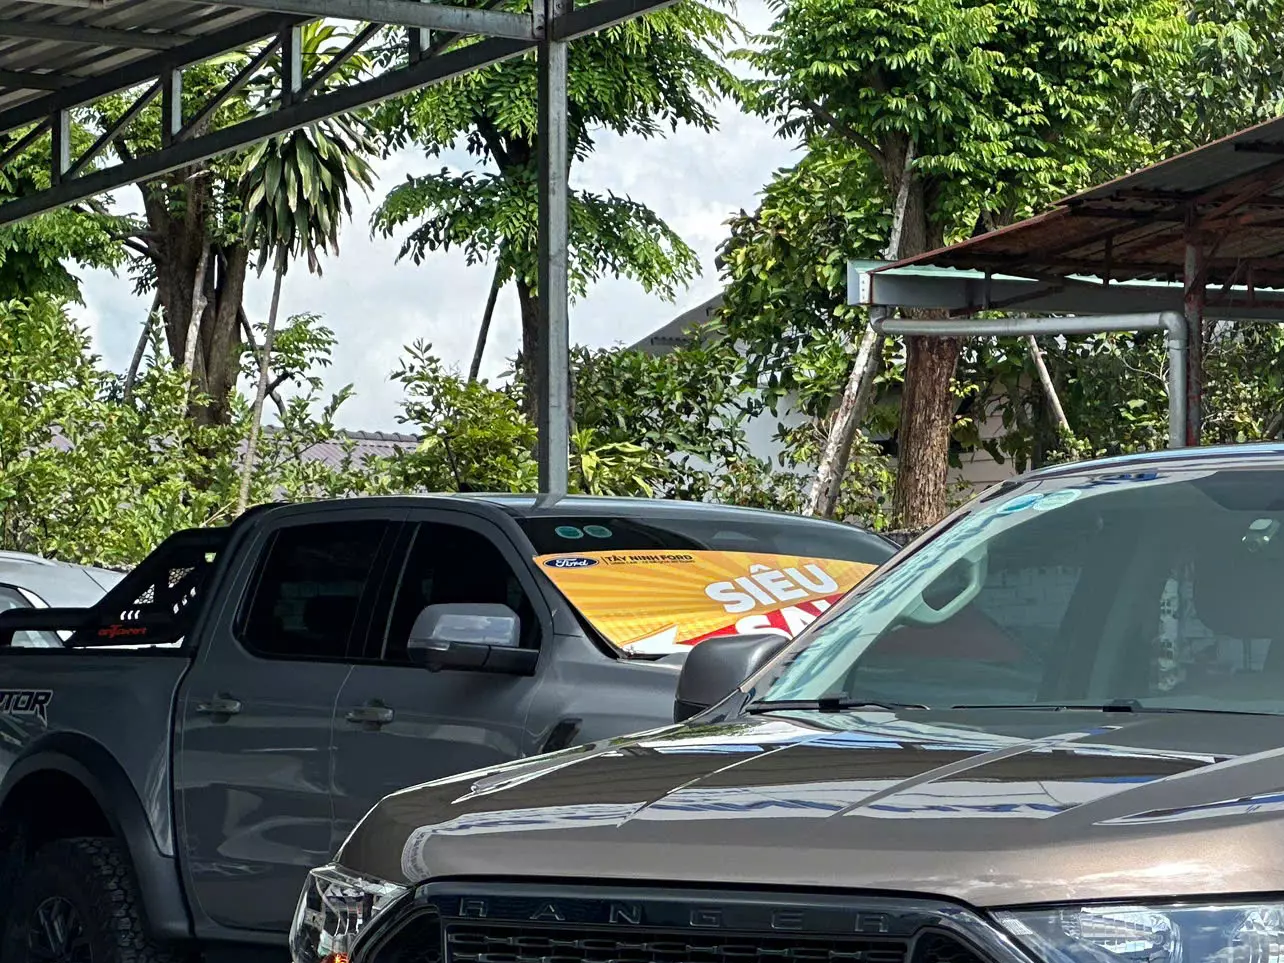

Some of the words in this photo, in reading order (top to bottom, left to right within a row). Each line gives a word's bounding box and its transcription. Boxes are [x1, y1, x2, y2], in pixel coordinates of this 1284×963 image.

[628, 554, 660, 562] NINH
[660, 554, 694, 562] FORD
[704, 563, 840, 614] SIÊU
[733, 599, 833, 641] SA
[459, 897, 889, 934] RANGER
